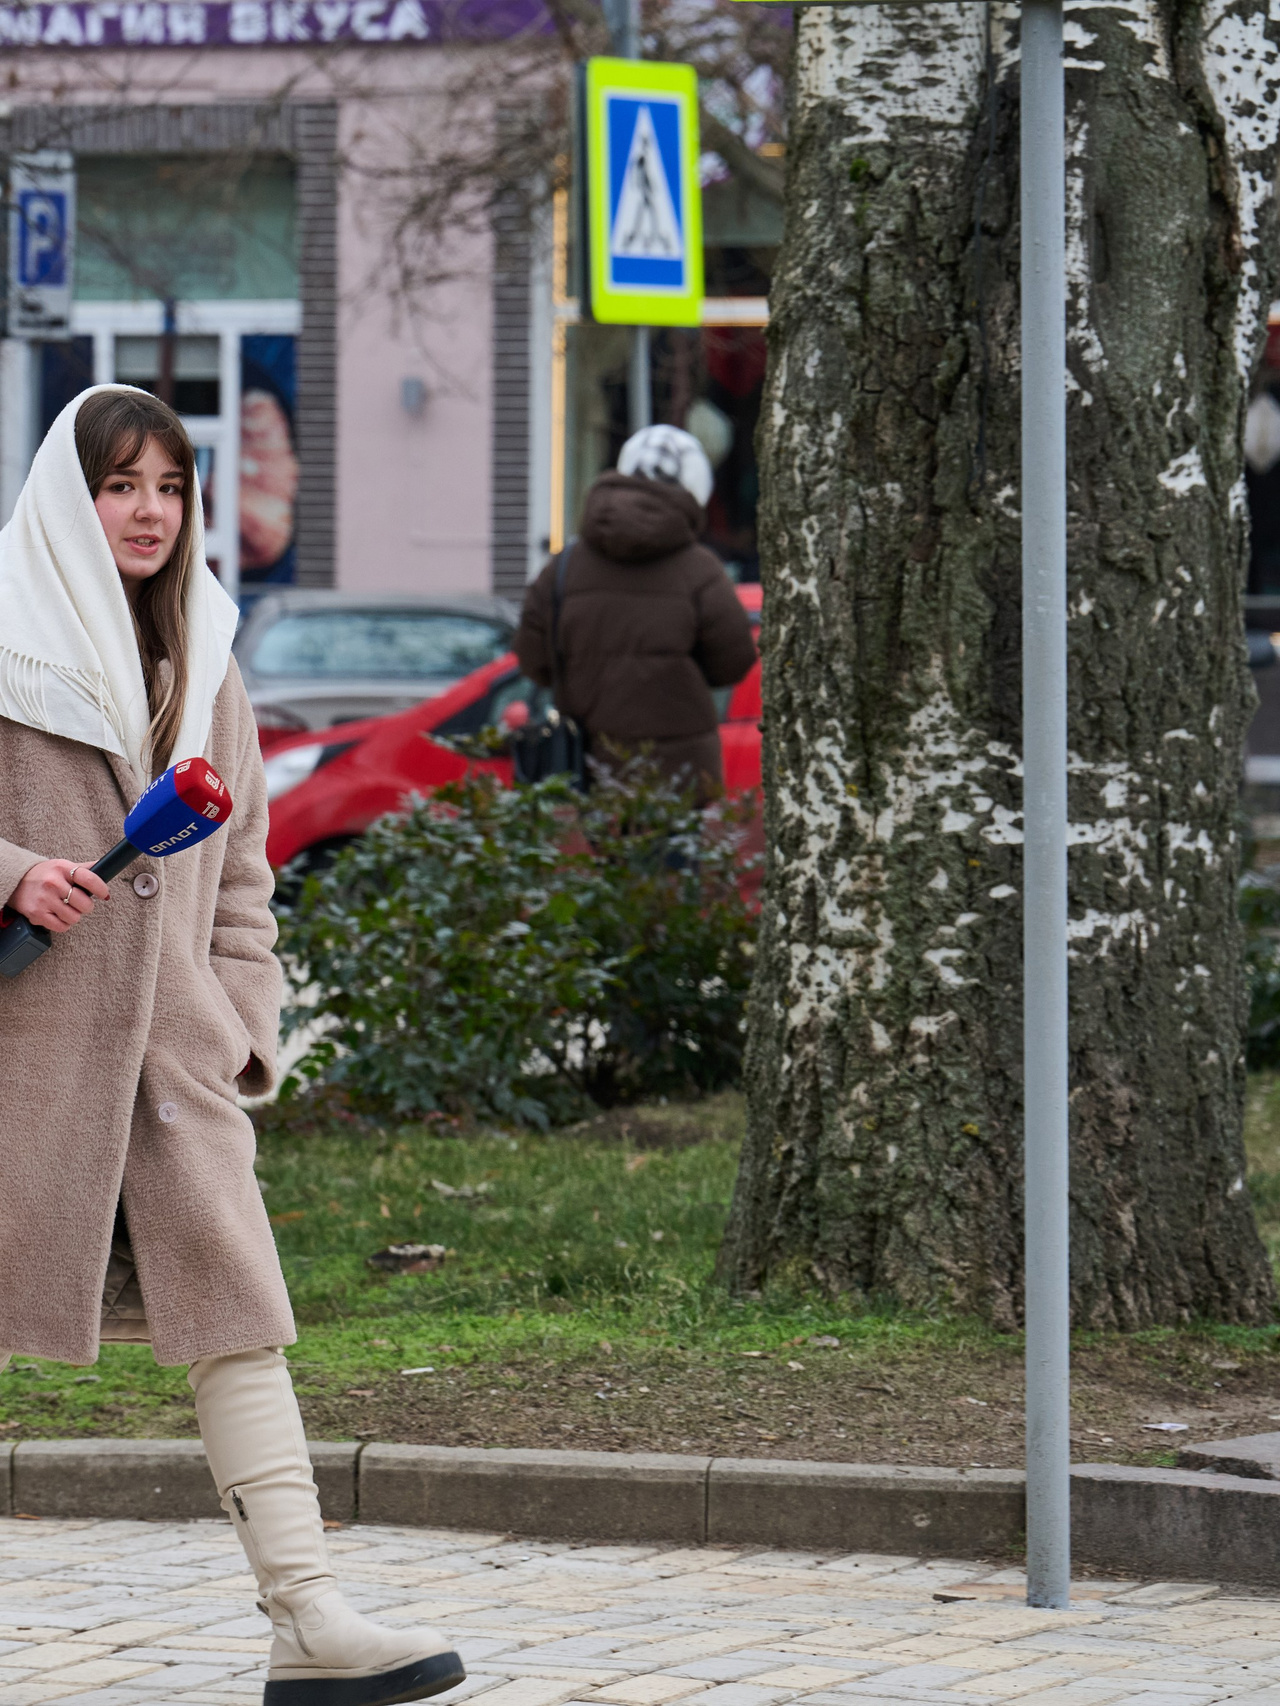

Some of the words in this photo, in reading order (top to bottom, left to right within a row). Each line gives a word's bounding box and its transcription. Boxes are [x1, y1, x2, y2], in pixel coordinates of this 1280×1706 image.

[229, 0, 430, 43] ВКУСА
[202, 801, 220, 819] ТВ
[149, 822, 199, 853] ОПЛОТ
